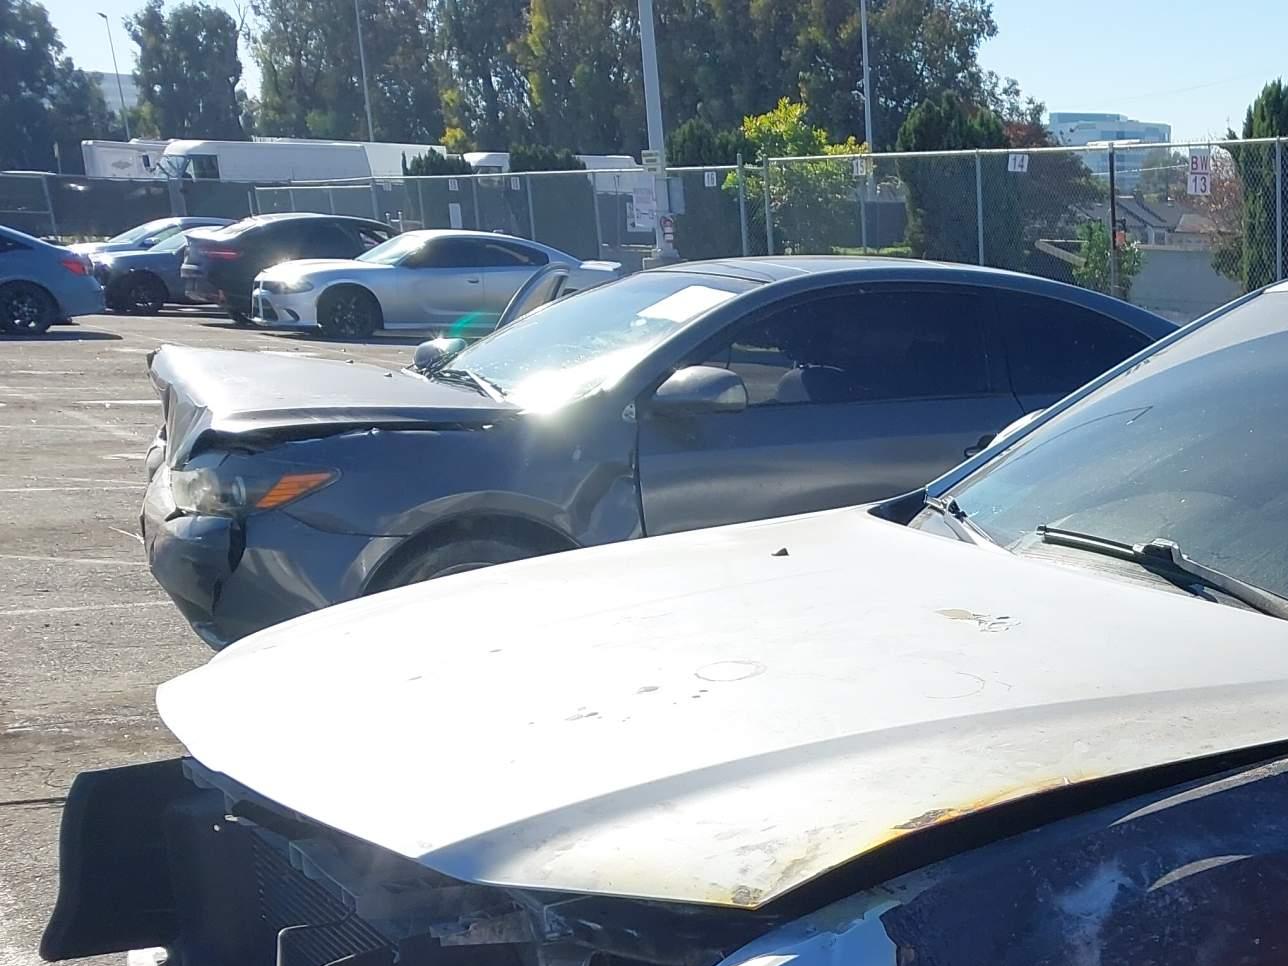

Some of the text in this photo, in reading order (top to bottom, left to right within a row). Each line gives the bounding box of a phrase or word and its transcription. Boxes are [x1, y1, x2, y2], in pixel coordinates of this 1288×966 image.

[1010, 153, 1025, 171] 14
[1191, 156, 1208, 171] BW
[1192, 175, 1207, 194] 13
